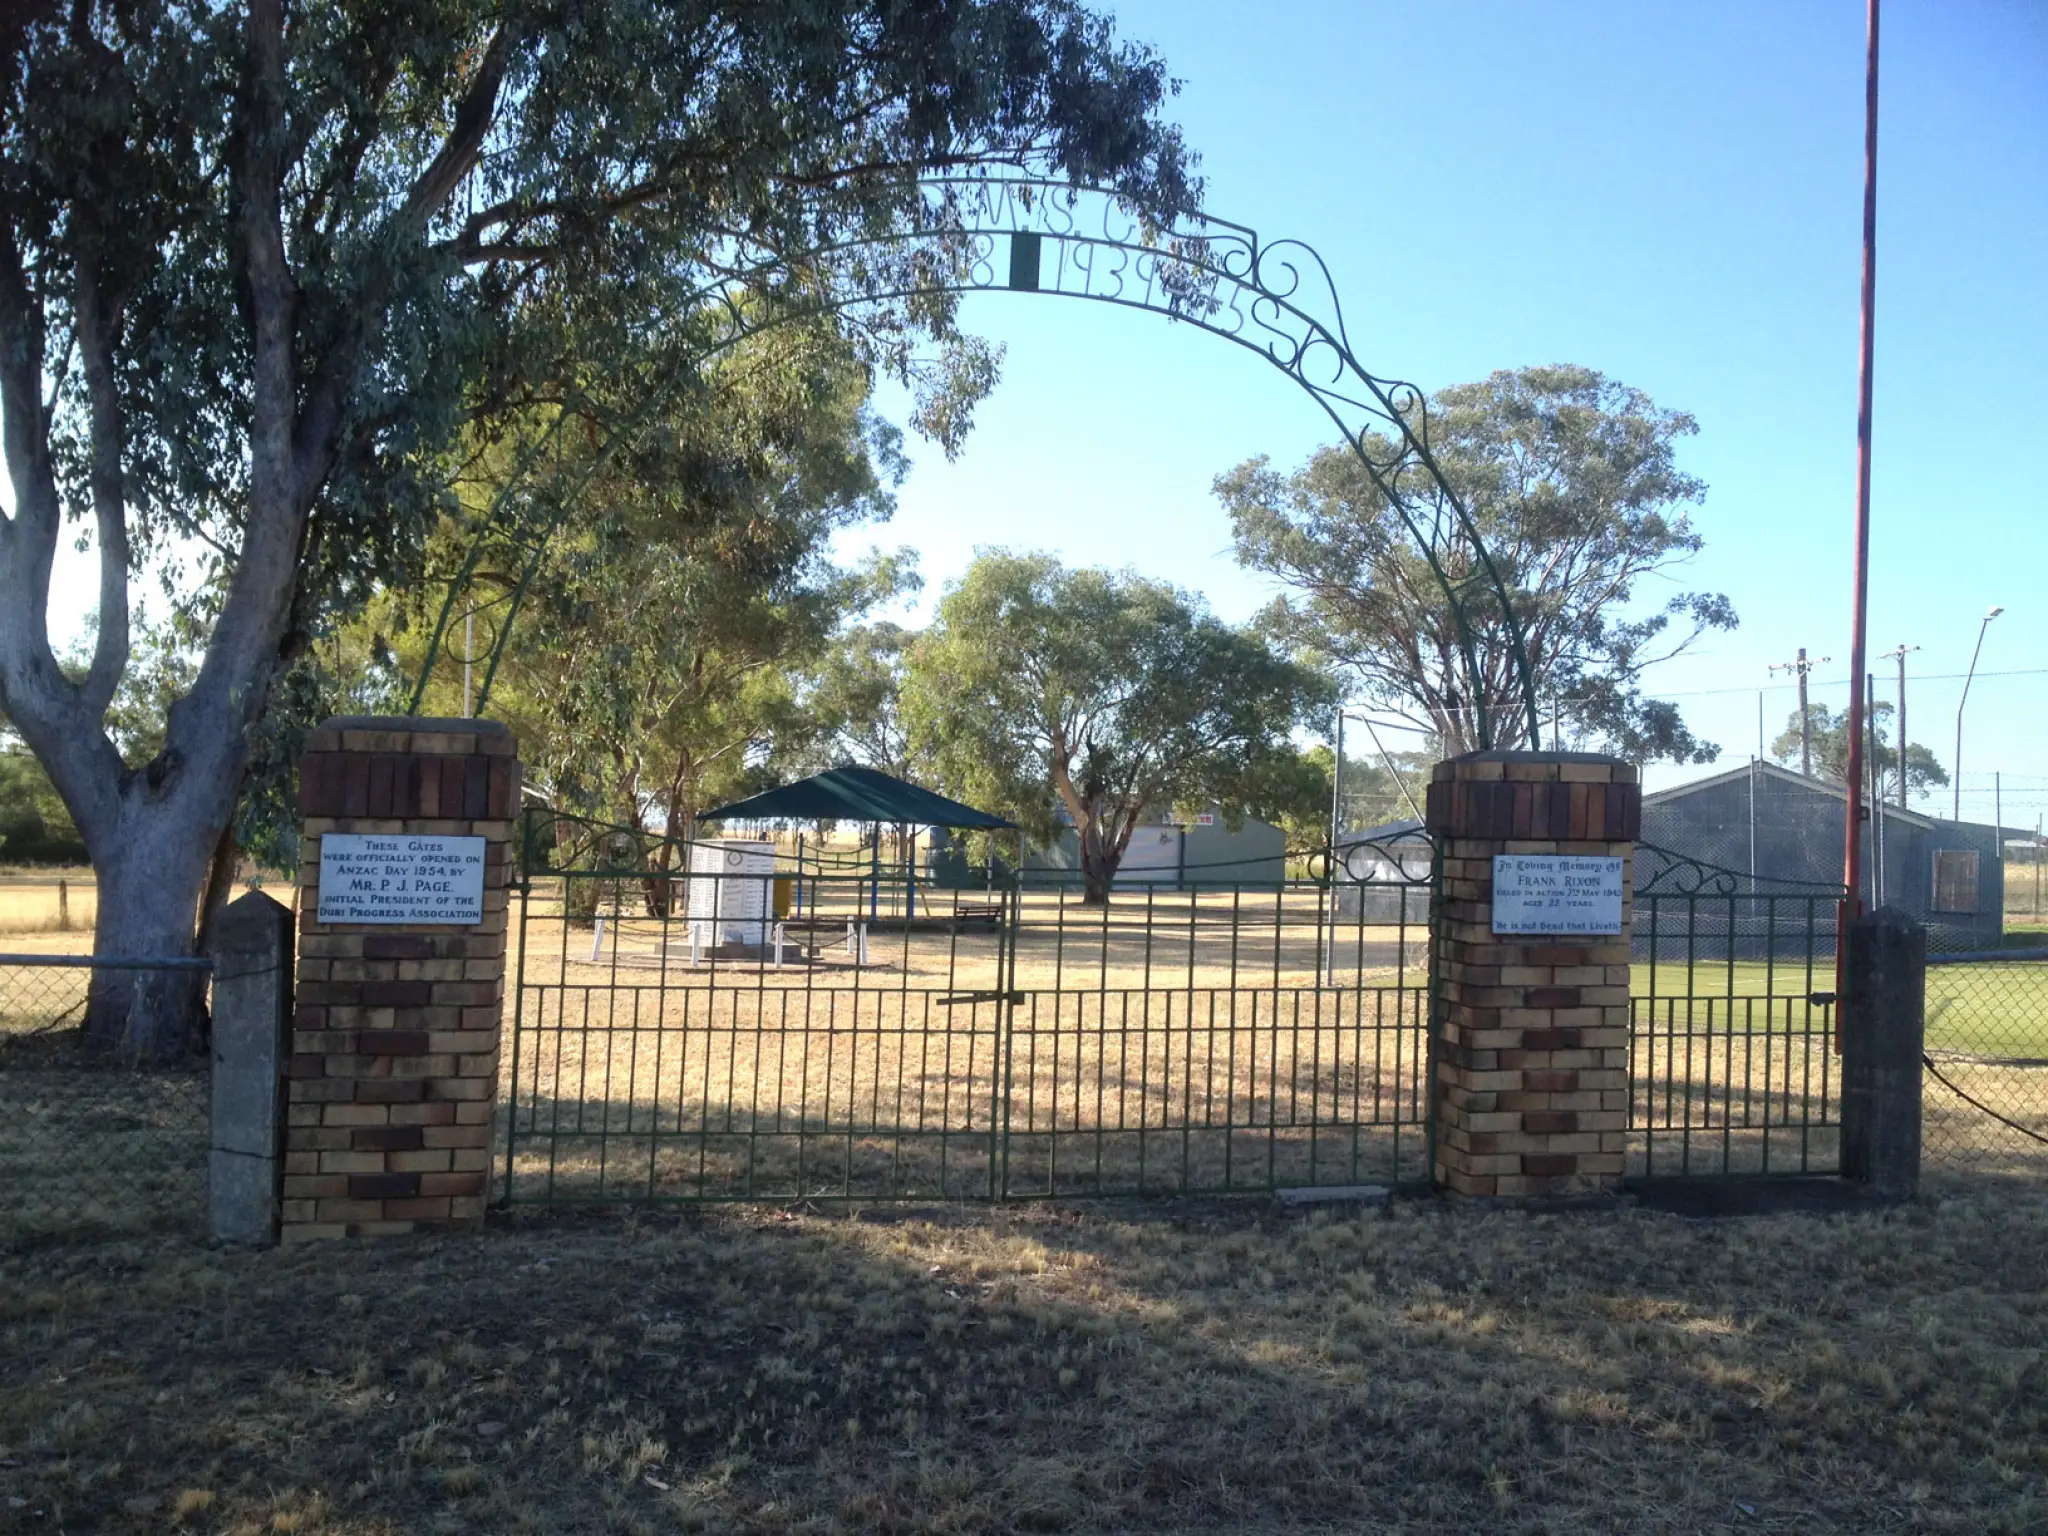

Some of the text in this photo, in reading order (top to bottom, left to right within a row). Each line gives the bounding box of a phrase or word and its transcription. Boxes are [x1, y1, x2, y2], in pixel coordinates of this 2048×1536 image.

[366, 841, 443, 851] THESE GATES
[323, 853, 480, 863] WERE OFFICIALLY OPENED ON
[336, 865, 379, 876] ANZAC
[385, 865, 410, 876] DAY
[450, 868, 467, 876] BY
[1557, 861, 1602, 873] Memory
[349, 879, 376, 891] MR.
[1518, 875, 1601, 886] FRANK RIXON
[1581, 888, 1600, 896] MAY
[325, 894, 475, 905] INITIAL PRESIDENT OF THE
[349, 907, 405, 917] PROGRESS
[408, 908, 480, 918] ASSOCIATION
